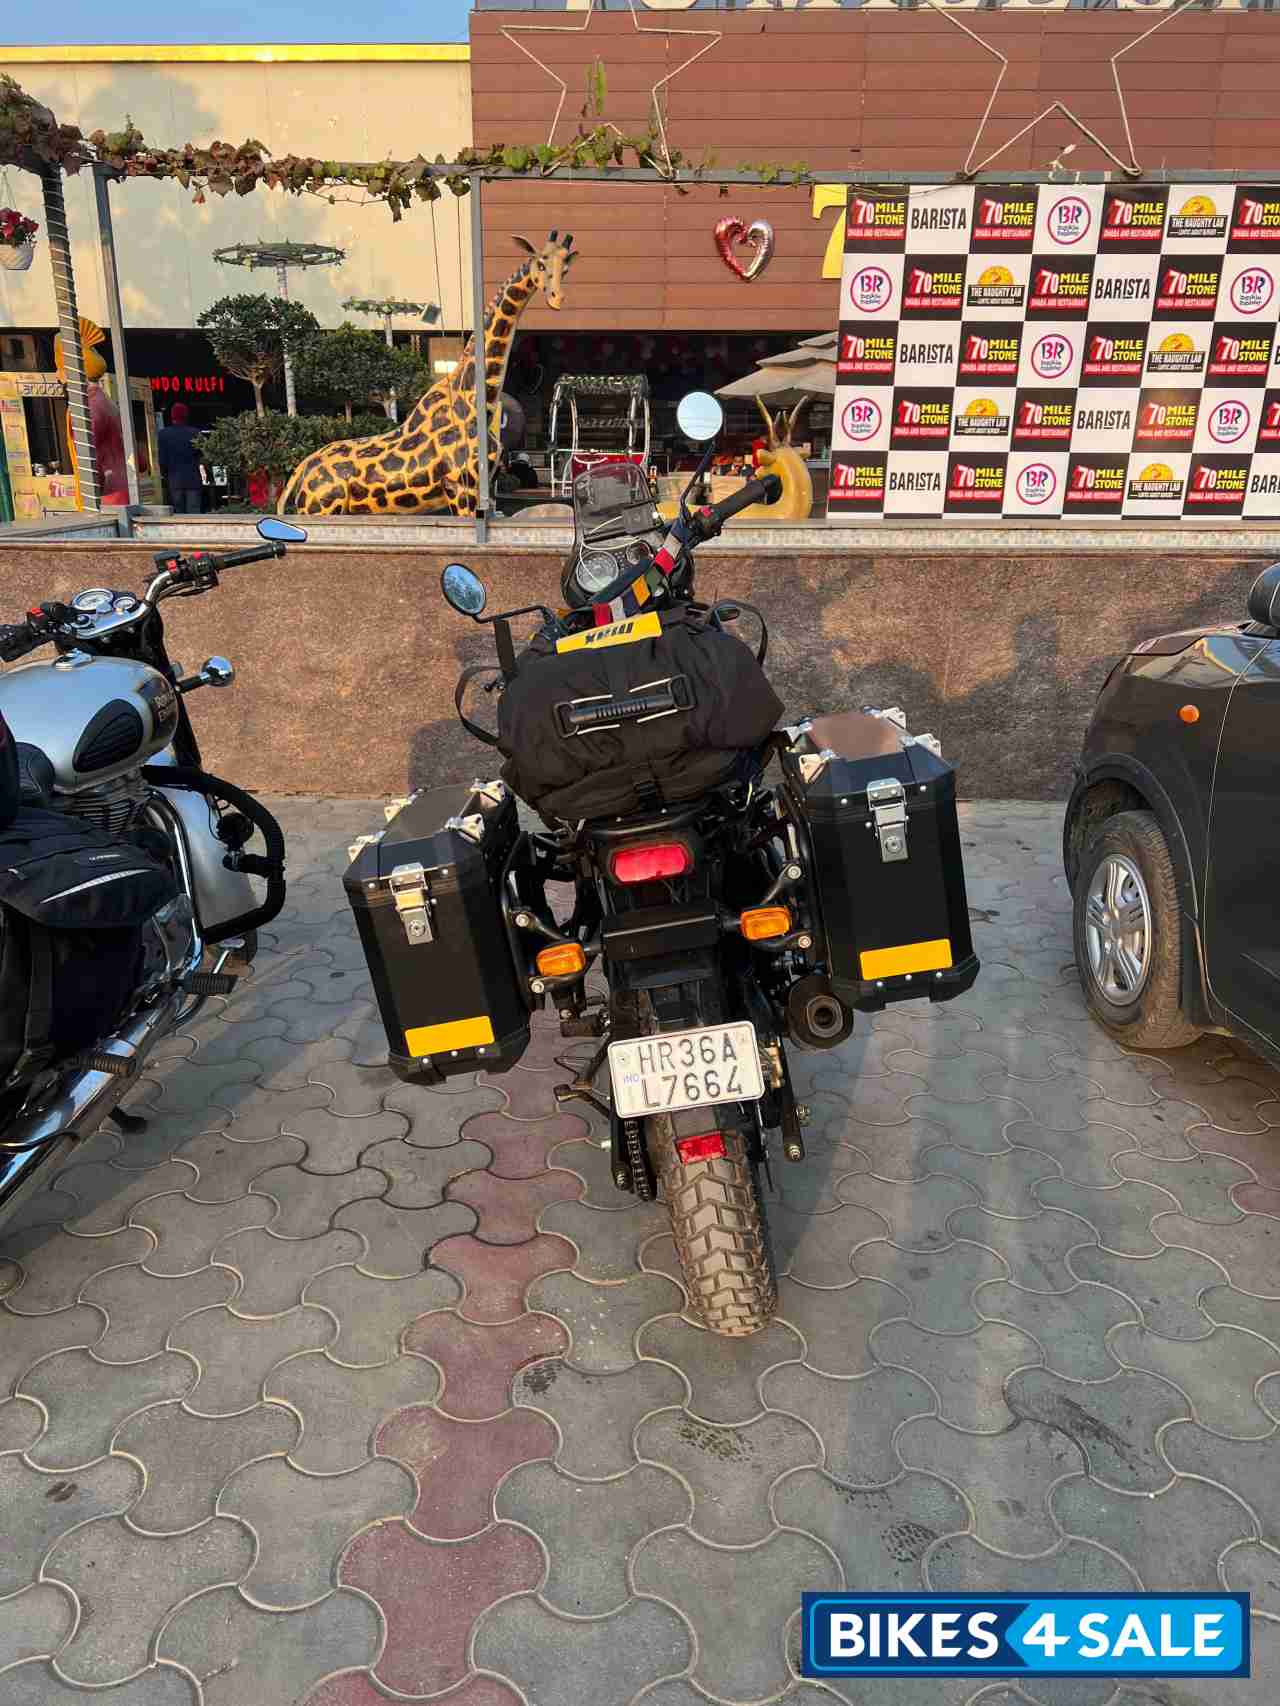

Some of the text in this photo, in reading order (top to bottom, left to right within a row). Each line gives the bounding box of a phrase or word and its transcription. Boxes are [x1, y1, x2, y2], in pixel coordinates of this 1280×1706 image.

[856, 199, 904, 224] 70 MILE
[875, 215, 904, 224] STONE
[911, 208, 967, 229] BARISTA
[984, 199, 1034, 224] 70 MILE
[1003, 215, 1033, 224] STONE
[1114, 199, 1164, 224] 70 MILE
[1133, 215, 1163, 224] STONE
[1244, 199, 1262, 224] 70
[913, 269, 962, 294] 70 MILE
[932, 285, 961, 294] STONE
[1041, 269, 1089, 294] 70 MILE
[1059, 285, 1089, 294] STONE
[1095, 278, 1150, 299] BARISTA
[1168, 269, 1217, 294] 70 MILE
[1186, 285, 1216, 295] STONE
[846, 336, 894, 358] 70 MILE
[865, 350, 893, 359] STONE
[900, 344, 953, 363] BARISTA
[971, 336, 1018, 358] 70 MILE
[988, 351, 1017, 360] STONE
[1095, 336, 1144, 360] 70 MILE
[1113, 351, 1143, 360] STONE
[1221, 336, 1270, 360] 70 MILE
[1239, 351, 1268, 360] STONE
[902, 400, 949, 424] 70 MILE
[920, 416, 949, 424] STONE
[1024, 401, 1072, 424] 70 MILE
[1042, 416, 1072, 425] STONE
[1077, 411, 1130, 429] BARISTA
[1148, 402, 1196, 425] 70 MILE
[1166, 417, 1196, 426] STONE
[838, 464, 883, 486] 70 MILE
[855, 478, 883, 487] STONE
[890, 472, 940, 490] BARISTA
[957, 465, 1003, 487] 70 MILE
[975, 479, 1003, 488] STONE
[1076, 465, 1124, 488] 70 MILE
[1094, 480, 1124, 489] STONE
[1198, 466, 1247, 489] 70 MILE
[1216, 481, 1245, 489] STONE
[638, 1032, 737, 1074] HR36A
[642, 1065, 743, 1107] L7664
